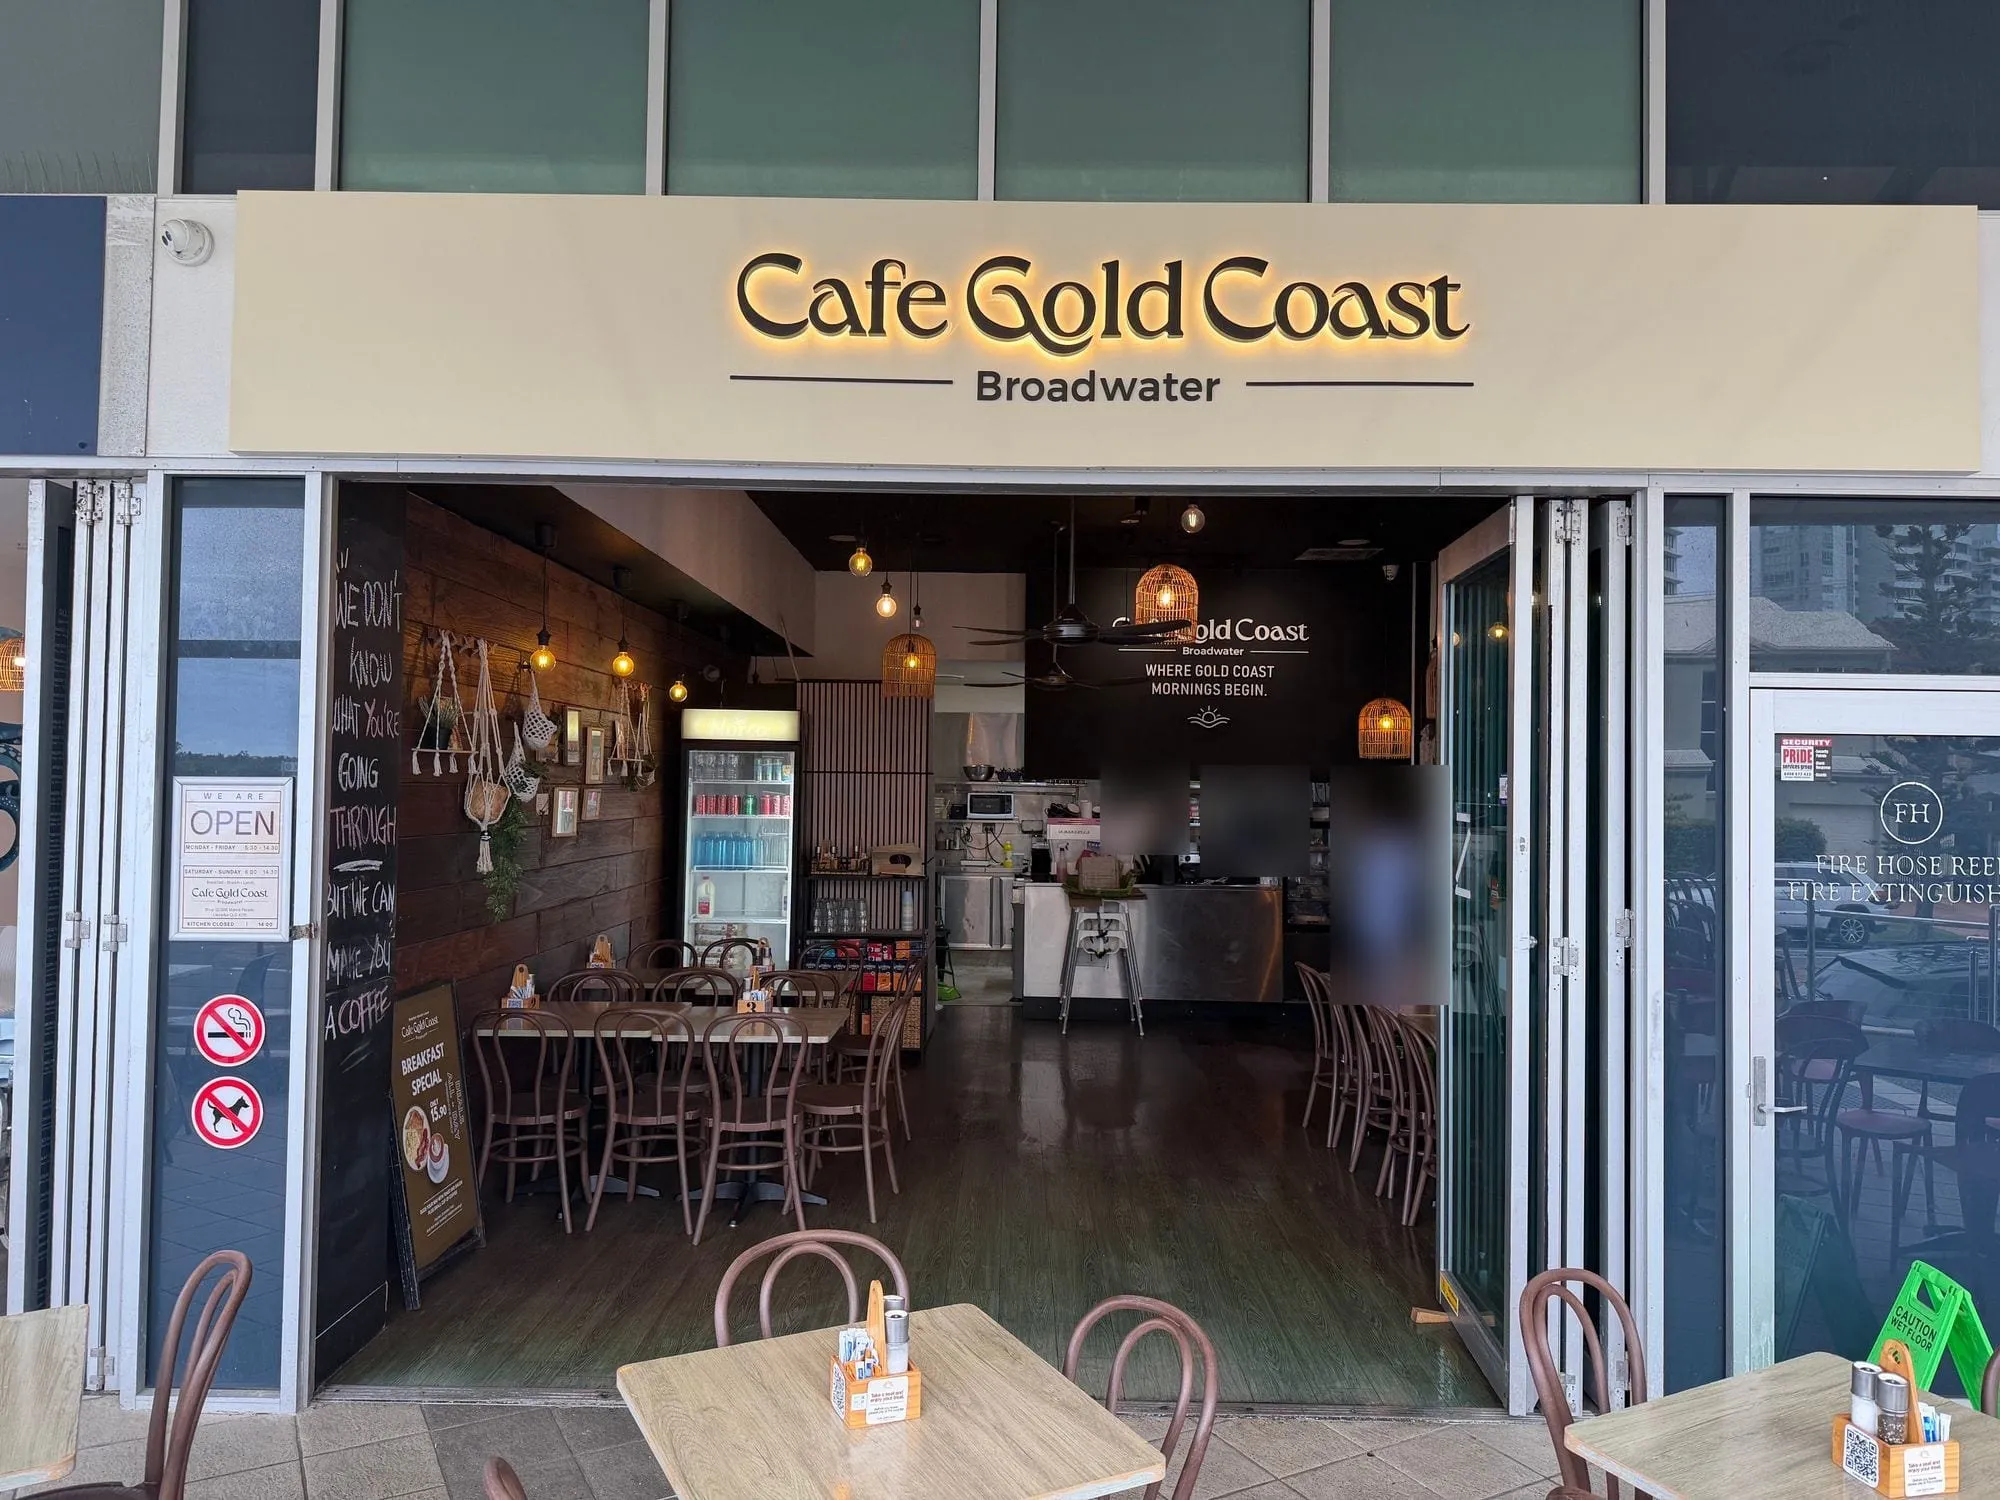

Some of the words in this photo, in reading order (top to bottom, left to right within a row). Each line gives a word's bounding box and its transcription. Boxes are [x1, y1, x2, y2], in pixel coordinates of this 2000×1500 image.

[737, 252, 950, 339] Cafe
[966, 255, 1184, 356] Gold
[1203, 256, 1470, 341] Coast
[976, 370, 1220, 402] Broadwater
[336, 581, 359, 630] WE
[362, 570, 402, 632] DON'T
[1178, 619, 1231, 643] old
[1235, 618, 1310, 641] Coast
[350, 637, 392, 690] KNOW
[1182, 646, 1244, 656] Broadwater
[1146, 664, 1191, 677] WHERE
[1195, 665, 1228, 677] GOLD
[1233, 665, 1275, 678] COAST
[1151, 682, 1221, 696] MORNINGS
[1225, 684, 1267, 696] BEGIN.
[332, 694, 361, 739] WHAT
[1782, 738, 1831, 746] SECURITY
[338, 752, 379, 792] GOING
[203, 792, 223, 800] WE
[236, 793, 264, 801] ARE
[190, 809, 275, 836] OPEN
[330, 804, 397, 852] THROUGH
[1894, 803, 1930, 824] FH
[1815, 854, 1868, 875] FIRE
[1876, 855, 1943, 876] HOSE
[191, 887, 215, 897] Cafe
[215, 887, 239, 899] Gold
[240, 888, 268, 898] Coast
[328, 881, 348, 919] BUT
[351, 878, 370, 917] WE
[371, 880, 395, 914] CAN
[1788, 881, 1840, 901] FIRE
[1851, 882, 2000, 904] EXTINGUISH
[327, 940, 364, 986] MAKE
[368, 933, 392, 975] YOU
[325, 1005, 336, 1040] A
[338, 985, 392, 1035] COFFEE
[401, 1041, 445, 1076] BREAKFAST
[411, 1068, 442, 1096] SPECIAL
[1891, 1316, 1908, 1333] WET
[1906, 1328, 1932, 1353] FLOOR
[1895, 1305, 1938, 1342] CAUTION
